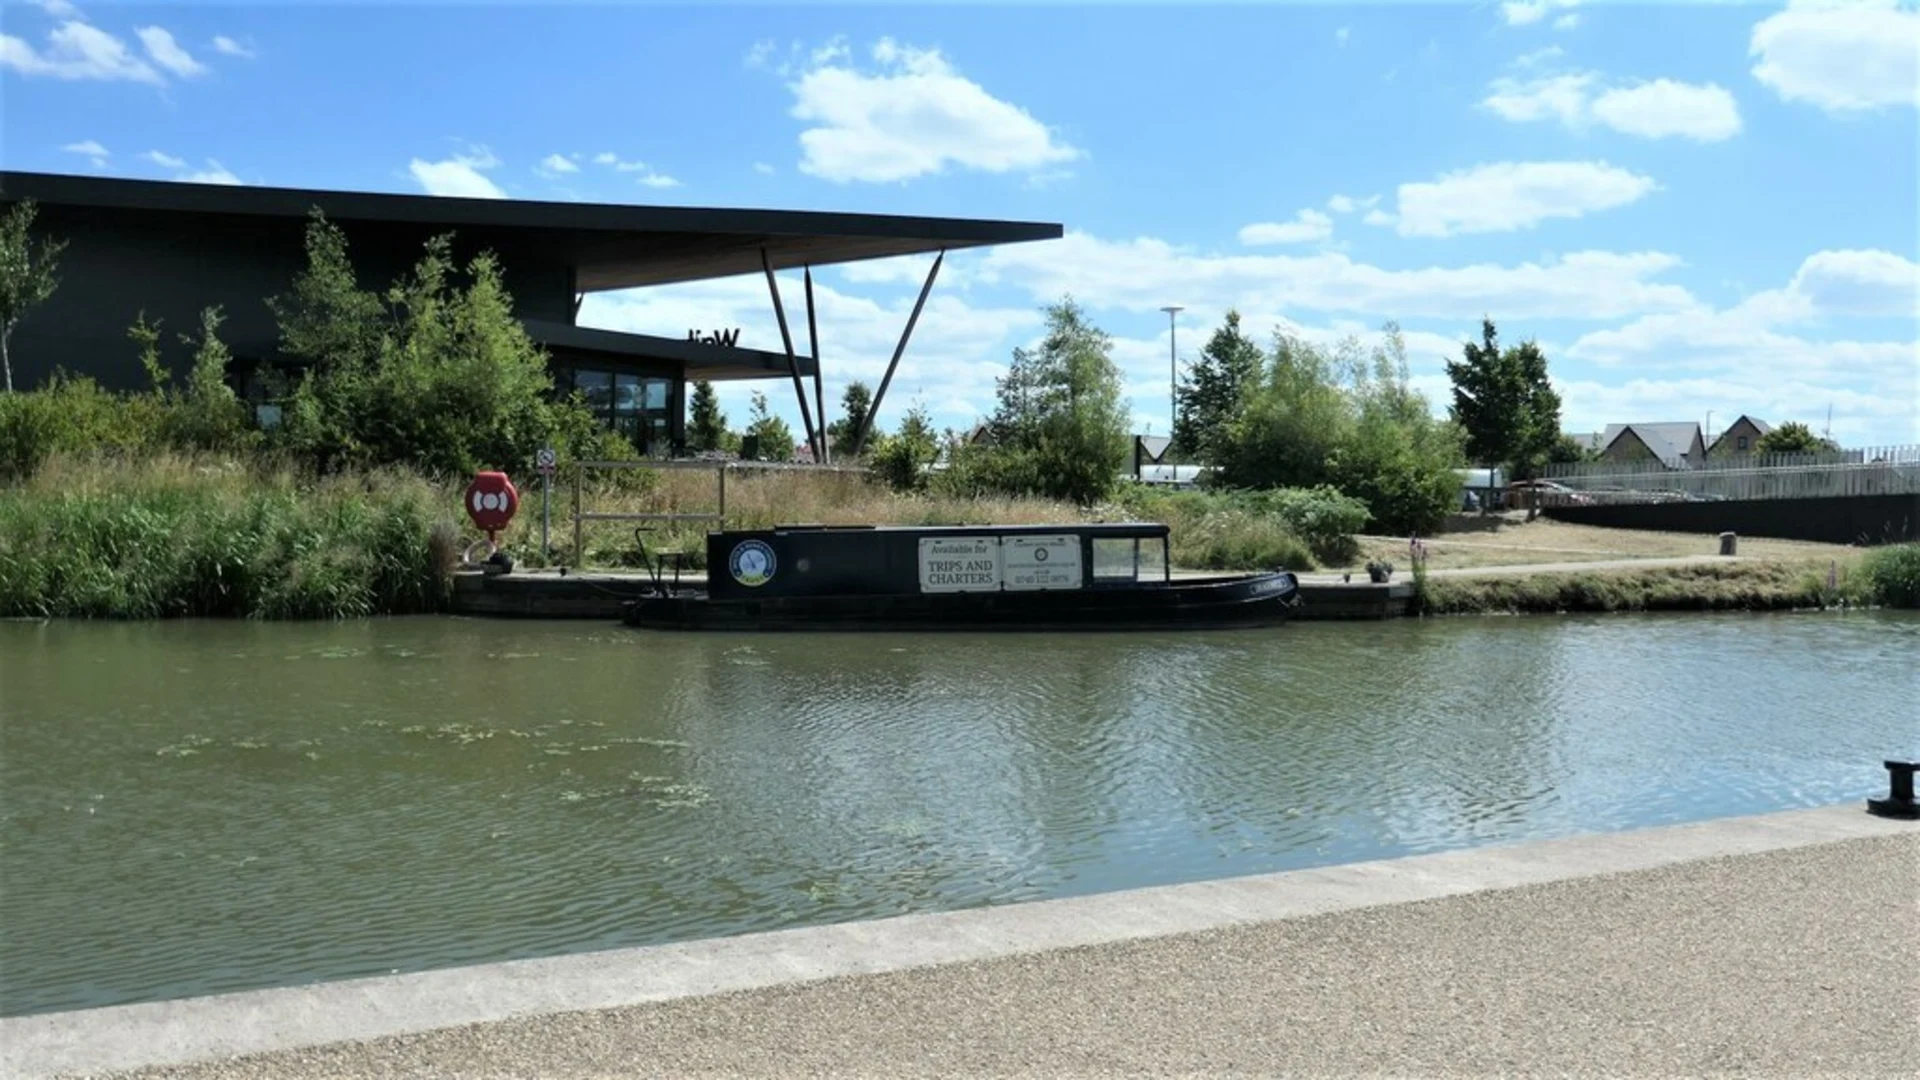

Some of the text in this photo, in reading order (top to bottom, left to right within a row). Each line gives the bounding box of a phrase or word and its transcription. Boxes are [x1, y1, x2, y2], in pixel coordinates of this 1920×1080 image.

[931, 544, 987, 554] Available for
[928, 560, 992, 572] TRIPS AND
[928, 572, 992, 584] CHARTERS
